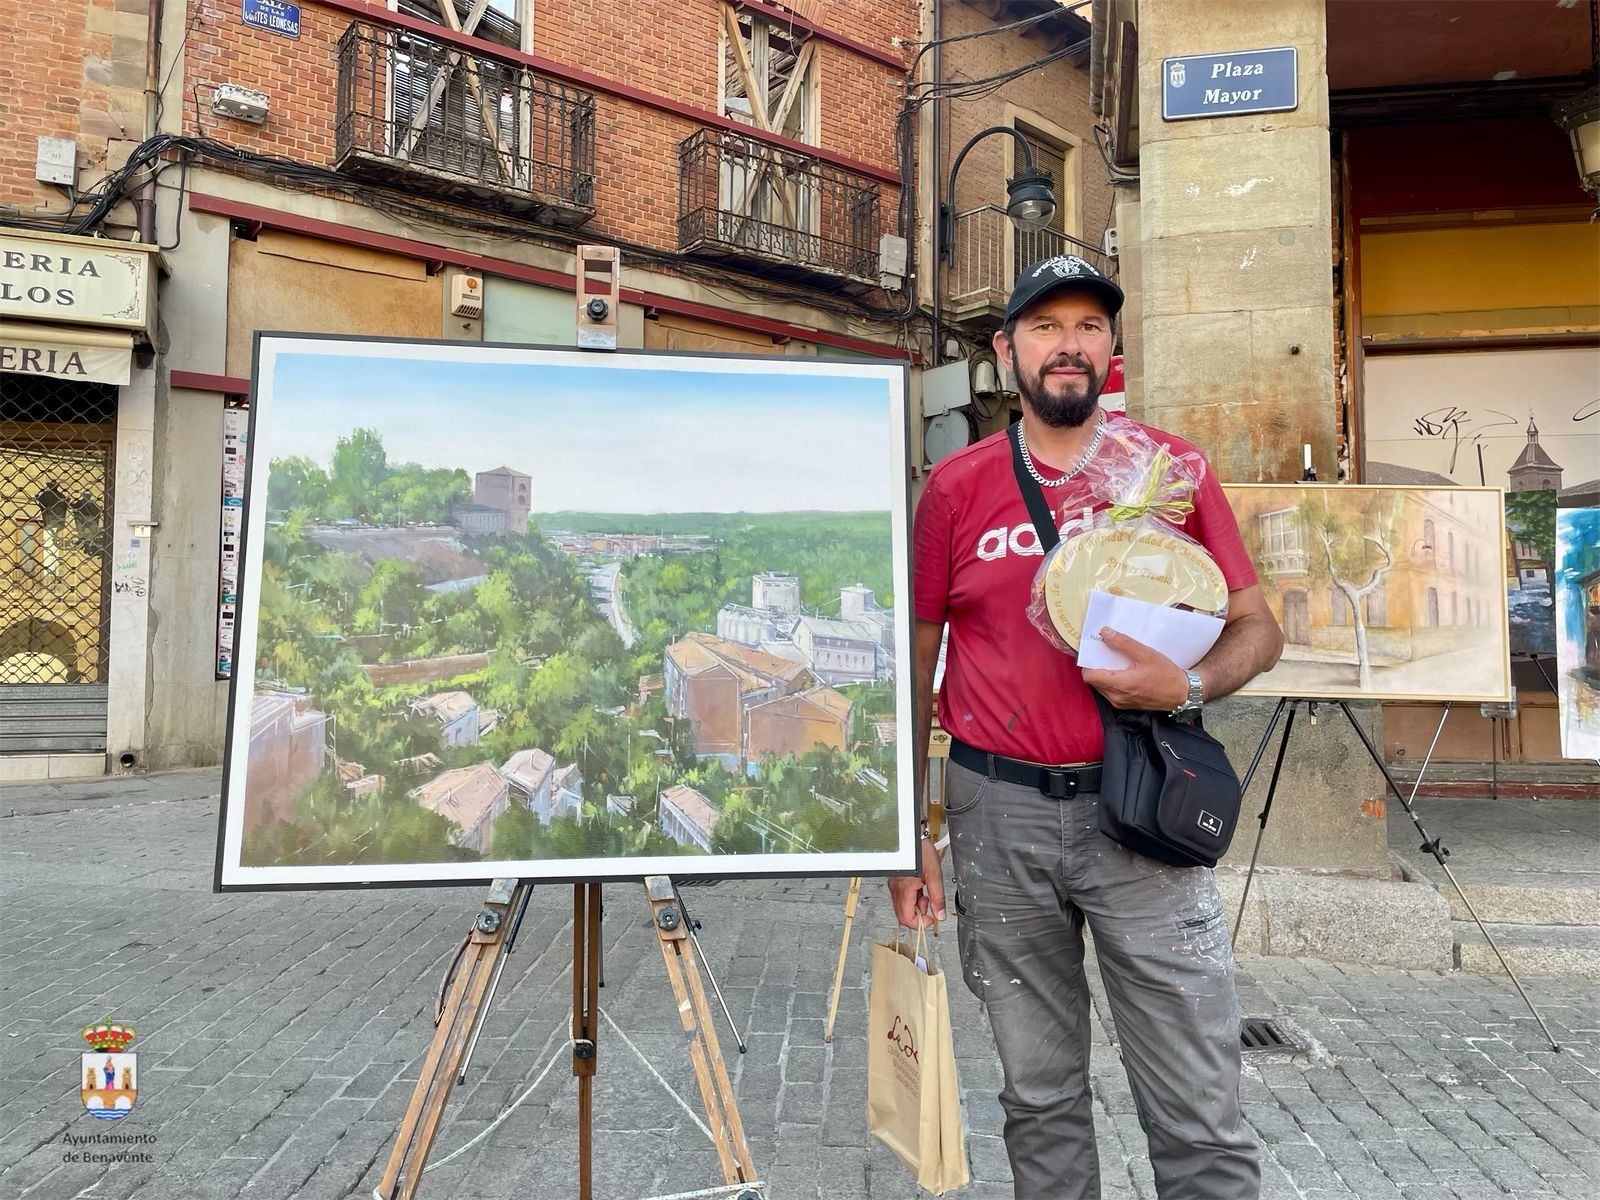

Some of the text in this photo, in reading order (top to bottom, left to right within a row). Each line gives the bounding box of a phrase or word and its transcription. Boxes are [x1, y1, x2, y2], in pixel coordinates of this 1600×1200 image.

[269, 14, 298, 34] LEONESAS
[1211, 62, 1264, 79] Plaza
[1203, 88, 1262, 105] Mayor
[3, 250, 101, 278] ERIA
[1032, 255, 1100, 278] SPECIAL FORCES
[1, 283, 75, 306] LOS
[0, 346, 87, 376] ERIA
